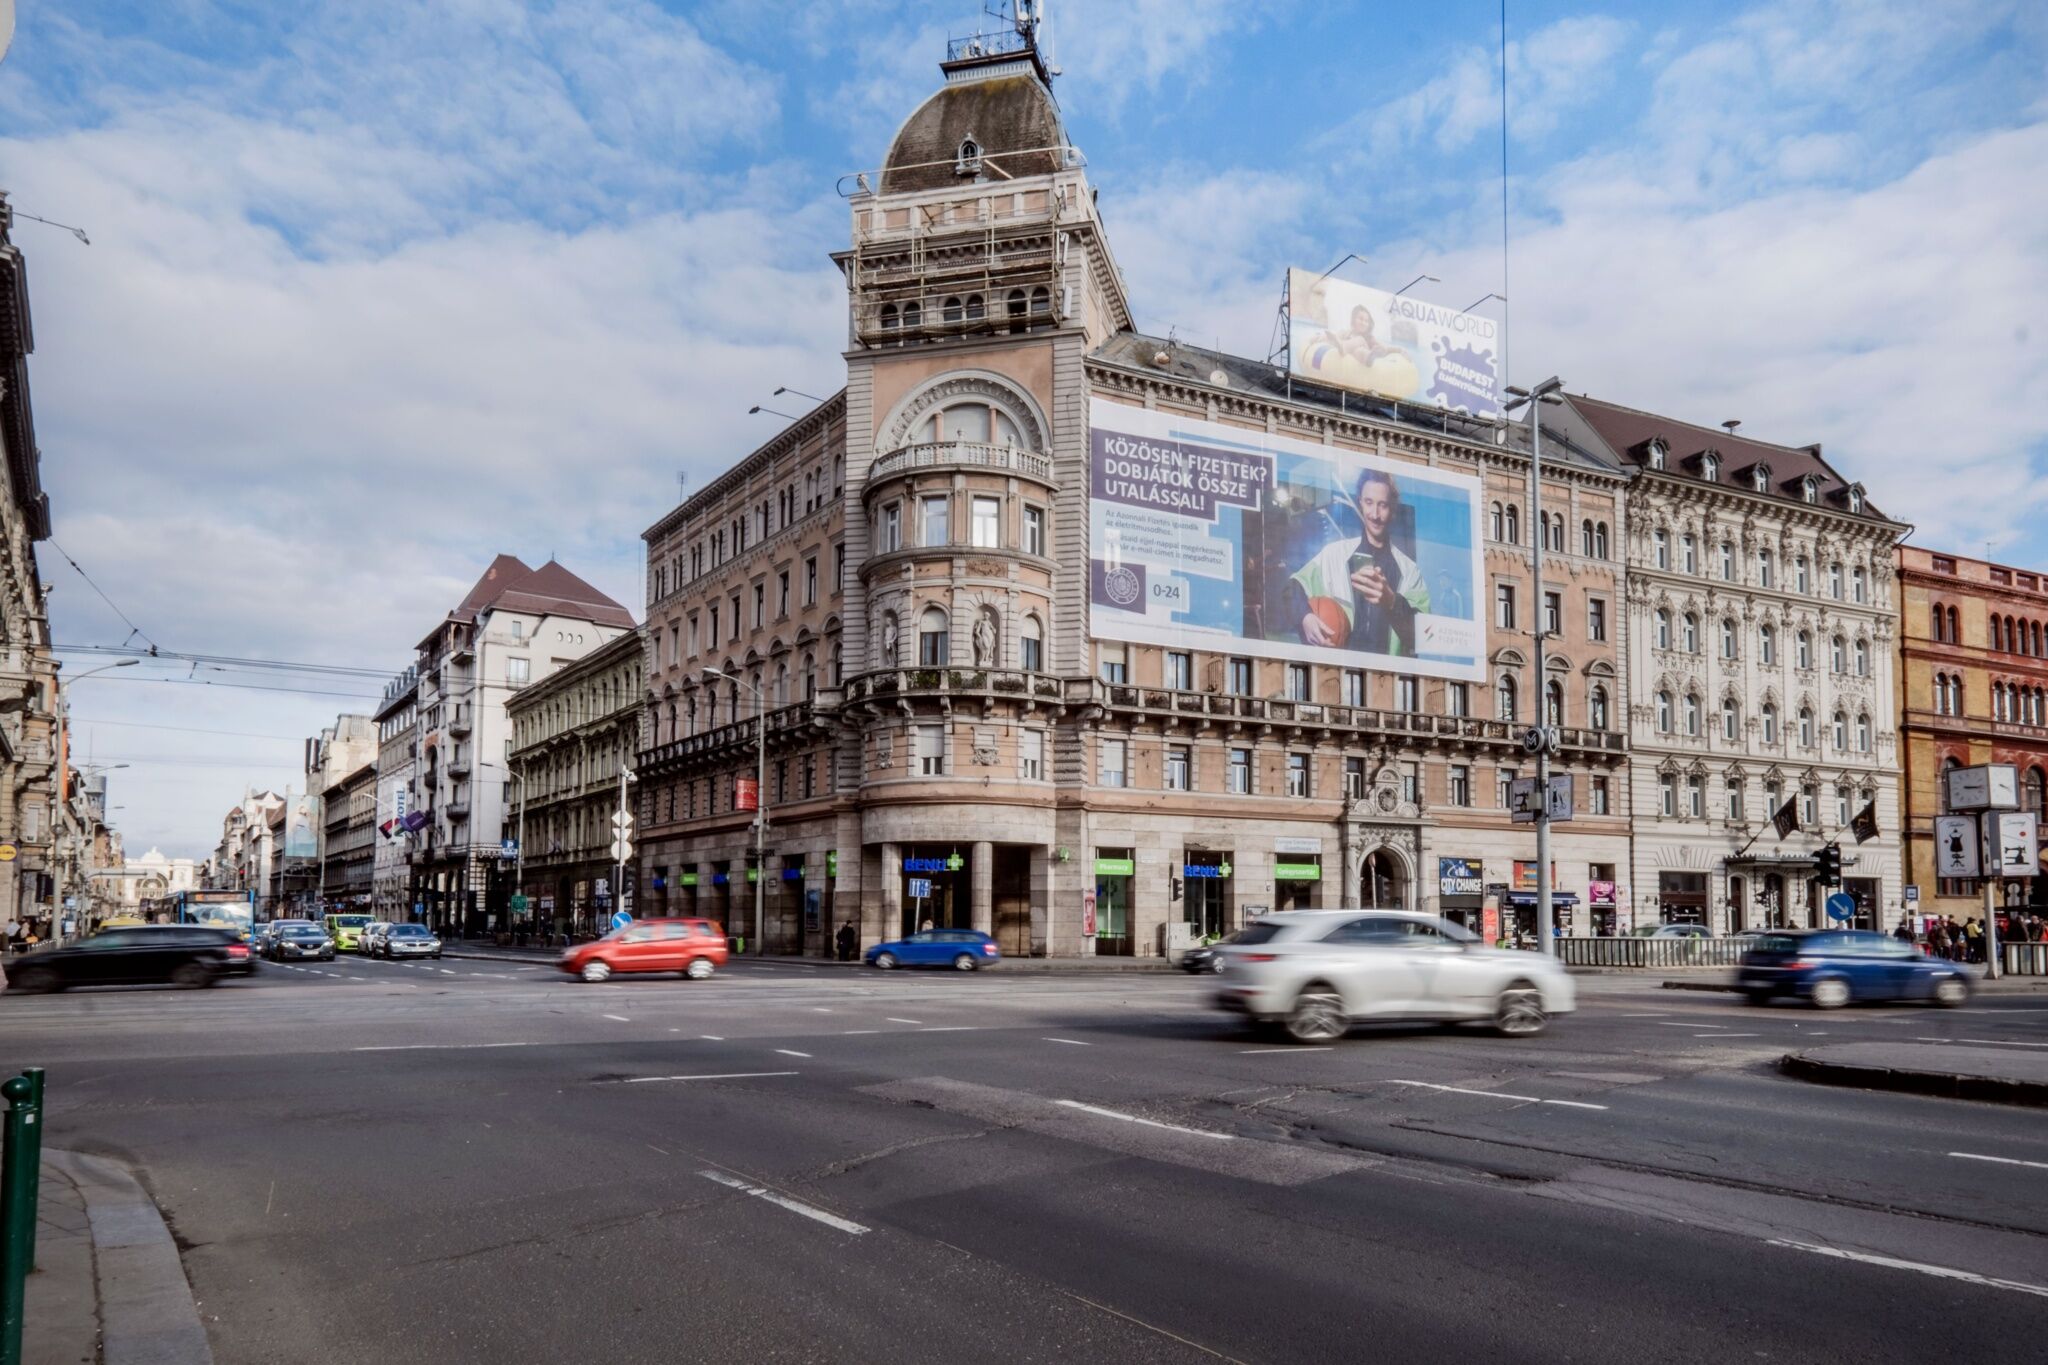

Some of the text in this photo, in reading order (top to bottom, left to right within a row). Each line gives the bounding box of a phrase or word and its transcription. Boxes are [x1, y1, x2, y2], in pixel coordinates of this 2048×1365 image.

[1439, 358, 1494, 388] BUDAPEST
[1104, 436, 1267, 482] KÖZÖSEN FIZETTEK?
[1105, 458, 1247, 498] DOBJÁTOK ÖSSZE
[1105, 478, 1205, 511] UTALÁSSAL!
[1153, 584, 1180, 599] 0-24
[904, 858, 946, 871] BENU
[1184, 864, 1218, 877] BENU
[1440, 878, 1455, 891] CITY
[1456, 878, 1482, 892] CHANGE
